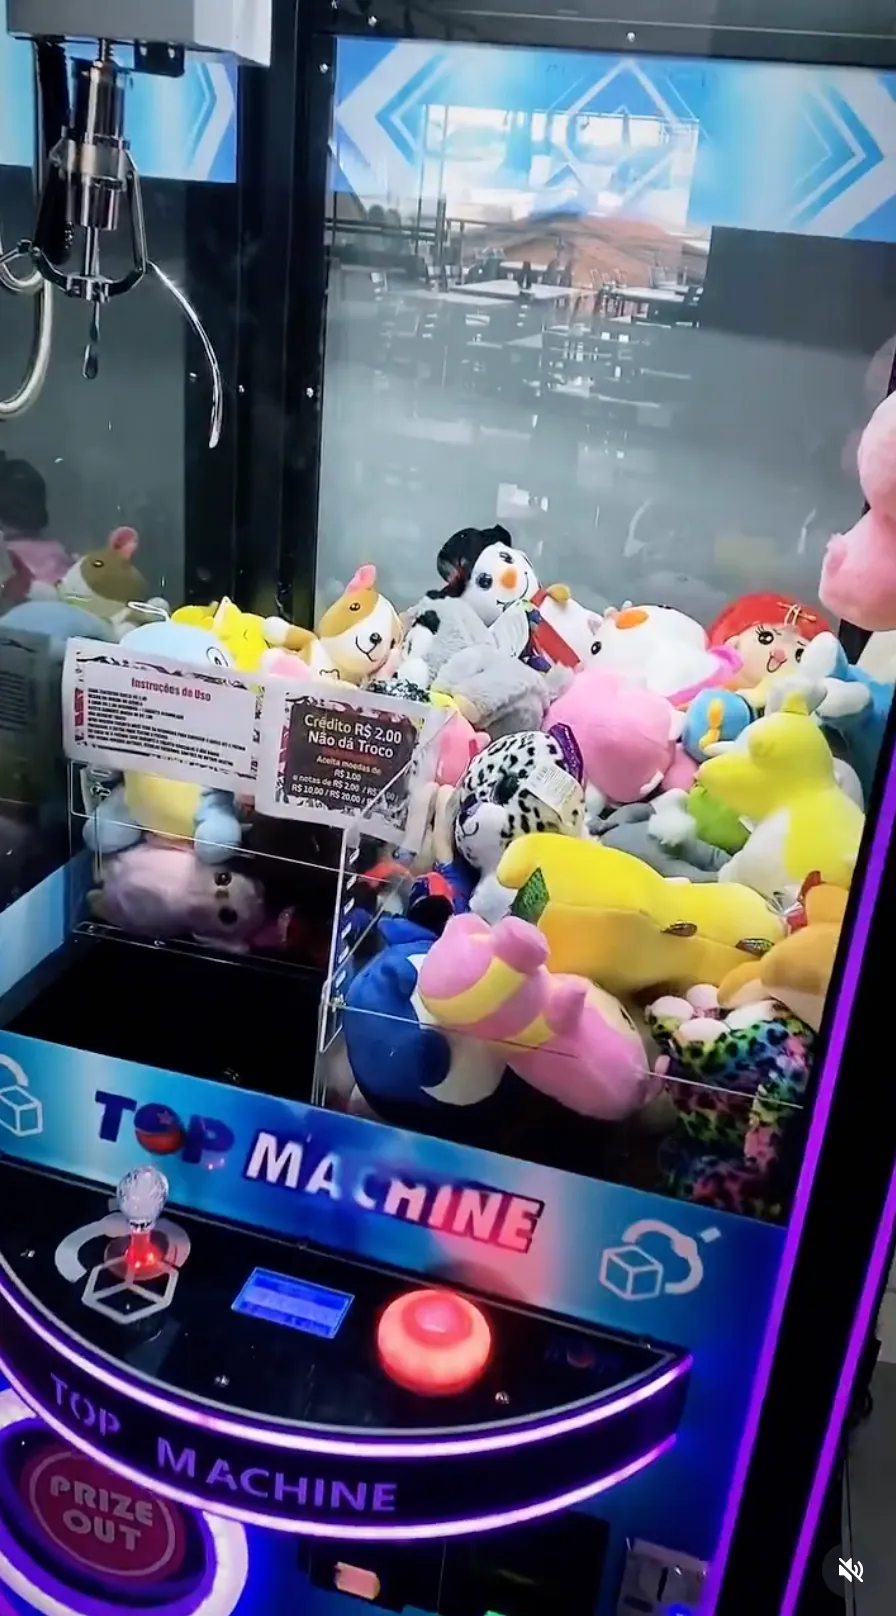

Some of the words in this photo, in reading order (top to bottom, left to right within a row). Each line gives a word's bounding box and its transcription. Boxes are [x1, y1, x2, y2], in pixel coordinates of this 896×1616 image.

[132, 677, 180, 695] Instruções
[195, 689, 211, 702] Uso
[304, 714, 352, 734] Crédito
[355, 722, 373, 740] R$
[308, 730, 335, 746] Não
[338, 736, 354, 750] dá
[358, 739, 394, 758] Troco
[316, 755, 340, 767] Aceita
[342, 761, 370, 773] moedas
[333, 768, 345, 779] R$
[292, 783, 302, 793] R$
[330, 790, 340, 799] R$
[299, 775, 321, 785] notas
[322, 778, 332, 787] de
[333, 779, 343, 789] R$
[367, 787, 377, 797] R$
[94, 1089, 235, 1165] TOP
[243, 1130, 544, 1254] MACHINE
[50, 1372, 121, 1437] TOP
[157, 1436, 397, 1512] MACHINE
[50, 1474, 153, 1527] PRIZE
[62, 1508, 141, 1551] OUT
